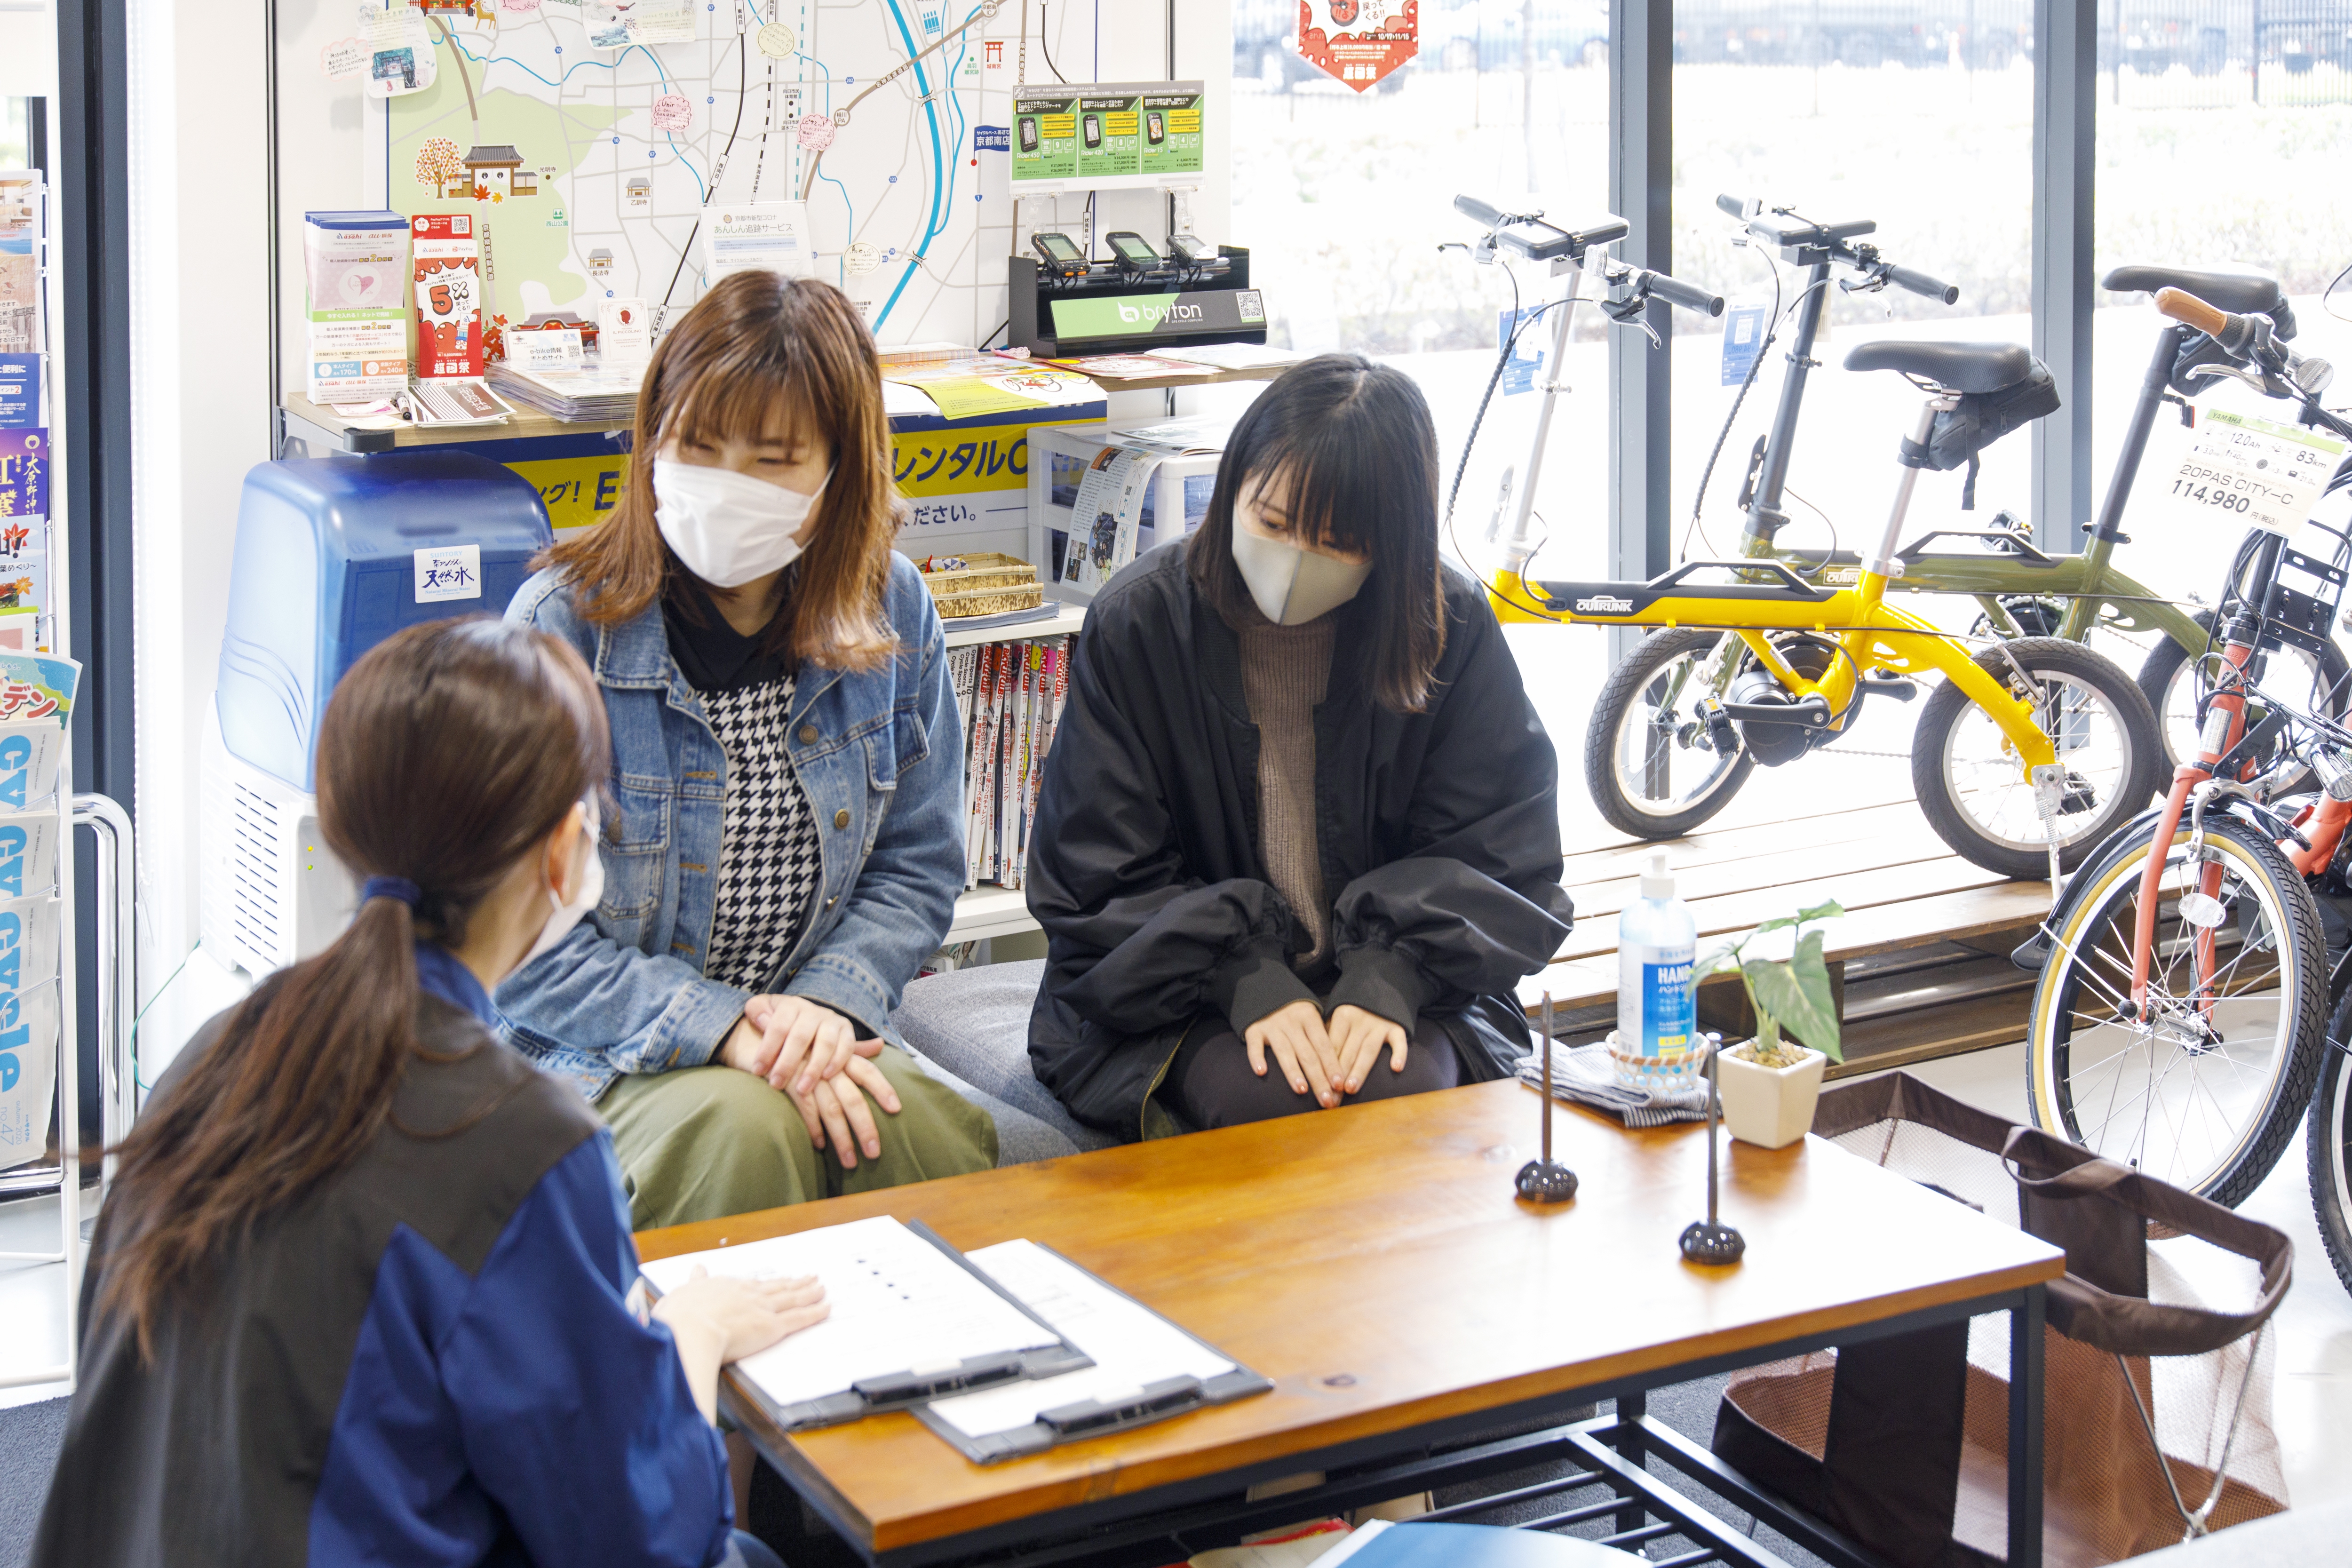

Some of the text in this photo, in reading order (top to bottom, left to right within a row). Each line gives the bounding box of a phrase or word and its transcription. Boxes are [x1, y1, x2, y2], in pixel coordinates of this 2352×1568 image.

[876, 63, 909, 88] 名神高速道路
[977, 135, 1009, 146] 京都南店
[715, 163, 723, 179] 西向日
[714, 223, 793, 233] あんしん追跡サービス
[482, 224, 494, 281] 京都縦貫自動車道
[1142, 302, 1202, 323] bryton
[0, 365, 26, 374] 便利に
[2212, 412, 2242, 425] YAMAHA
[2228, 432, 2326, 469] 12.0Ah 83km
[23, 452, 41, 515] 大原野神
[2180, 465, 2293, 505] 20PAS CITY-C
[2172, 480, 2249, 513] 114,980
[433, 559, 462, 568] 南アルプスの
[421, 566, 474, 588] 天然水
[1576, 598, 1633, 612] OUTRUNK
[967, 685, 973, 694] 10
[0, 683, 57, 719] デン
[1017, 721, 1026, 803] バーチャルライド完全ガイド
[1026, 769, 1036, 828] 自転車インドアスタイル
